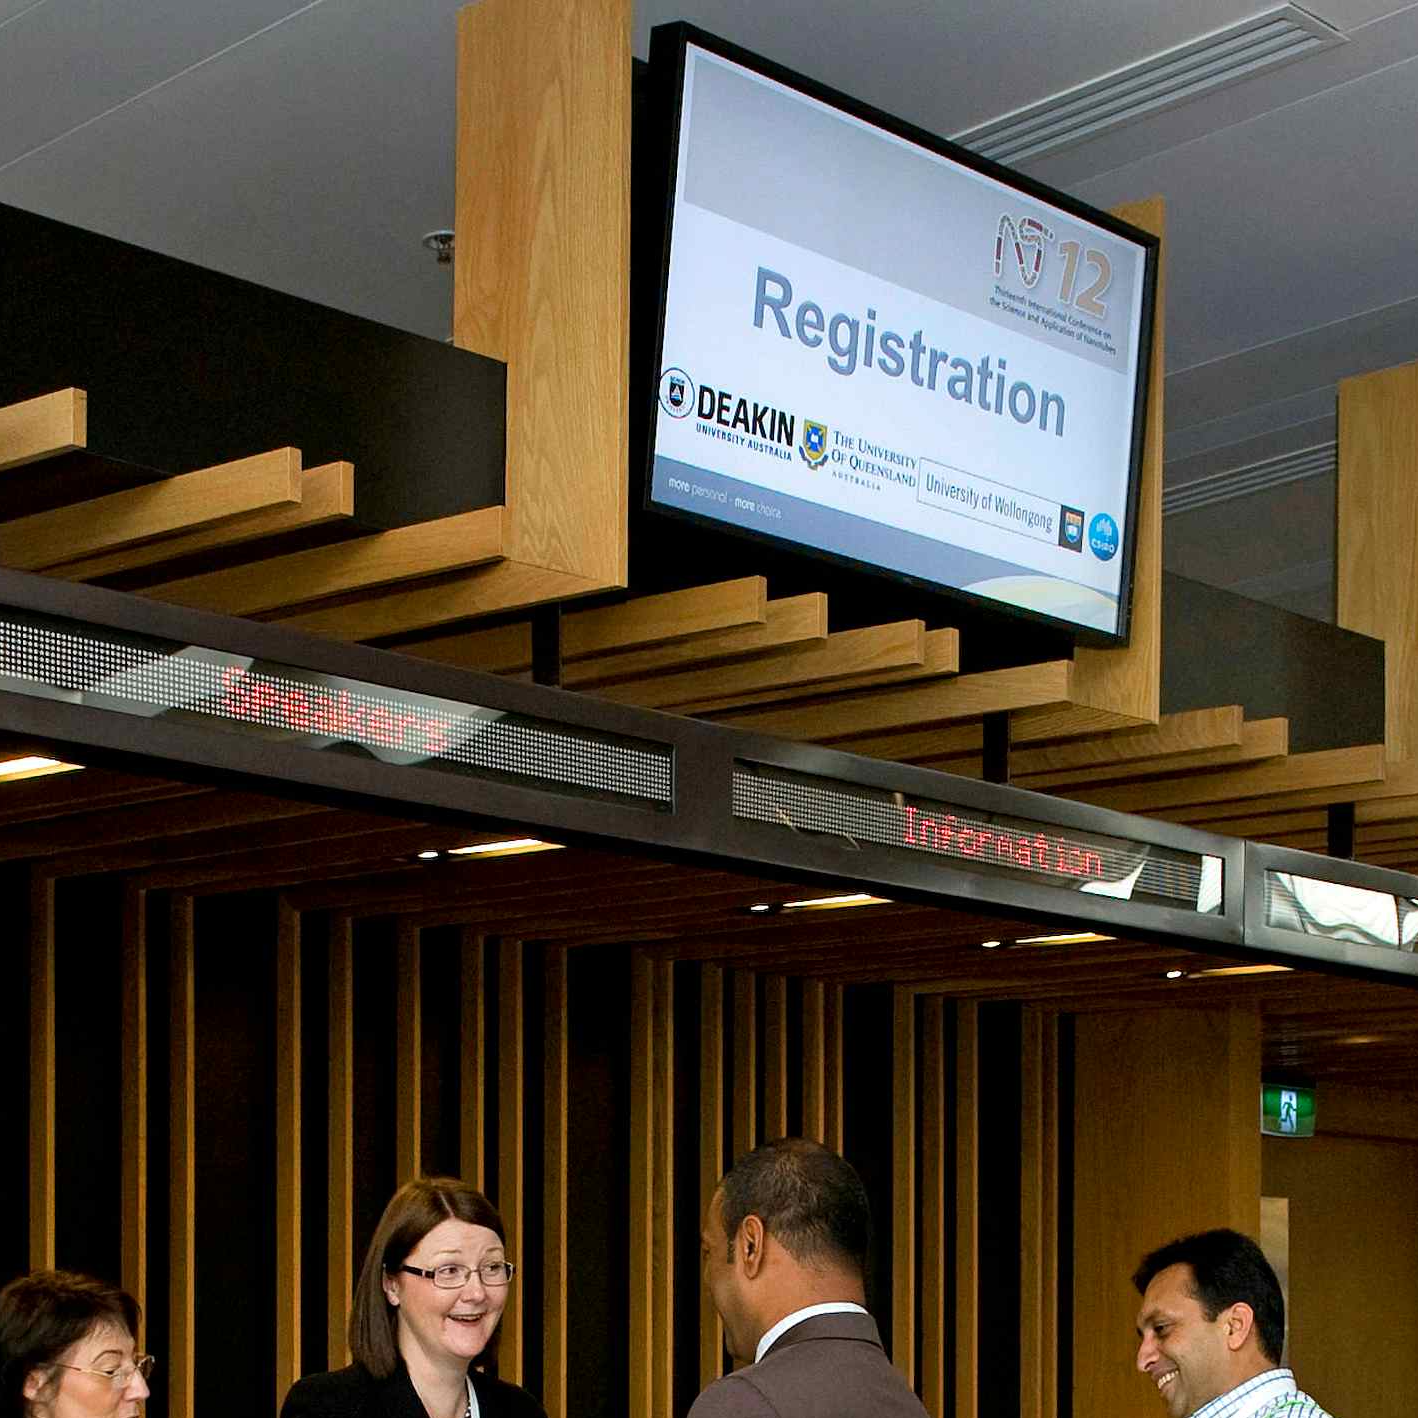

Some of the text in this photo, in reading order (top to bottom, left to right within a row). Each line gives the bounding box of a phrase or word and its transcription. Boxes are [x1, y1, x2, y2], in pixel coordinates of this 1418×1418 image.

[1058, 241, 1112, 320] 12
[753, 265, 1066, 437] Registration
[697, 384, 795, 447] DEAKIN
[696, 423, 792, 461] UNIVERSITY AUSTRALIA
[833, 430, 917, 470] THE UNIVERSITY
[831, 449, 917, 488] OF QUEENSLAND
[832, 471, 881, 491] AUSTRALIA
[668, 477, 690, 492] more
[734, 497, 755, 512] more
[926, 472, 1053, 534] University of Wollongong
[221, 665, 450, 753] Speakers
